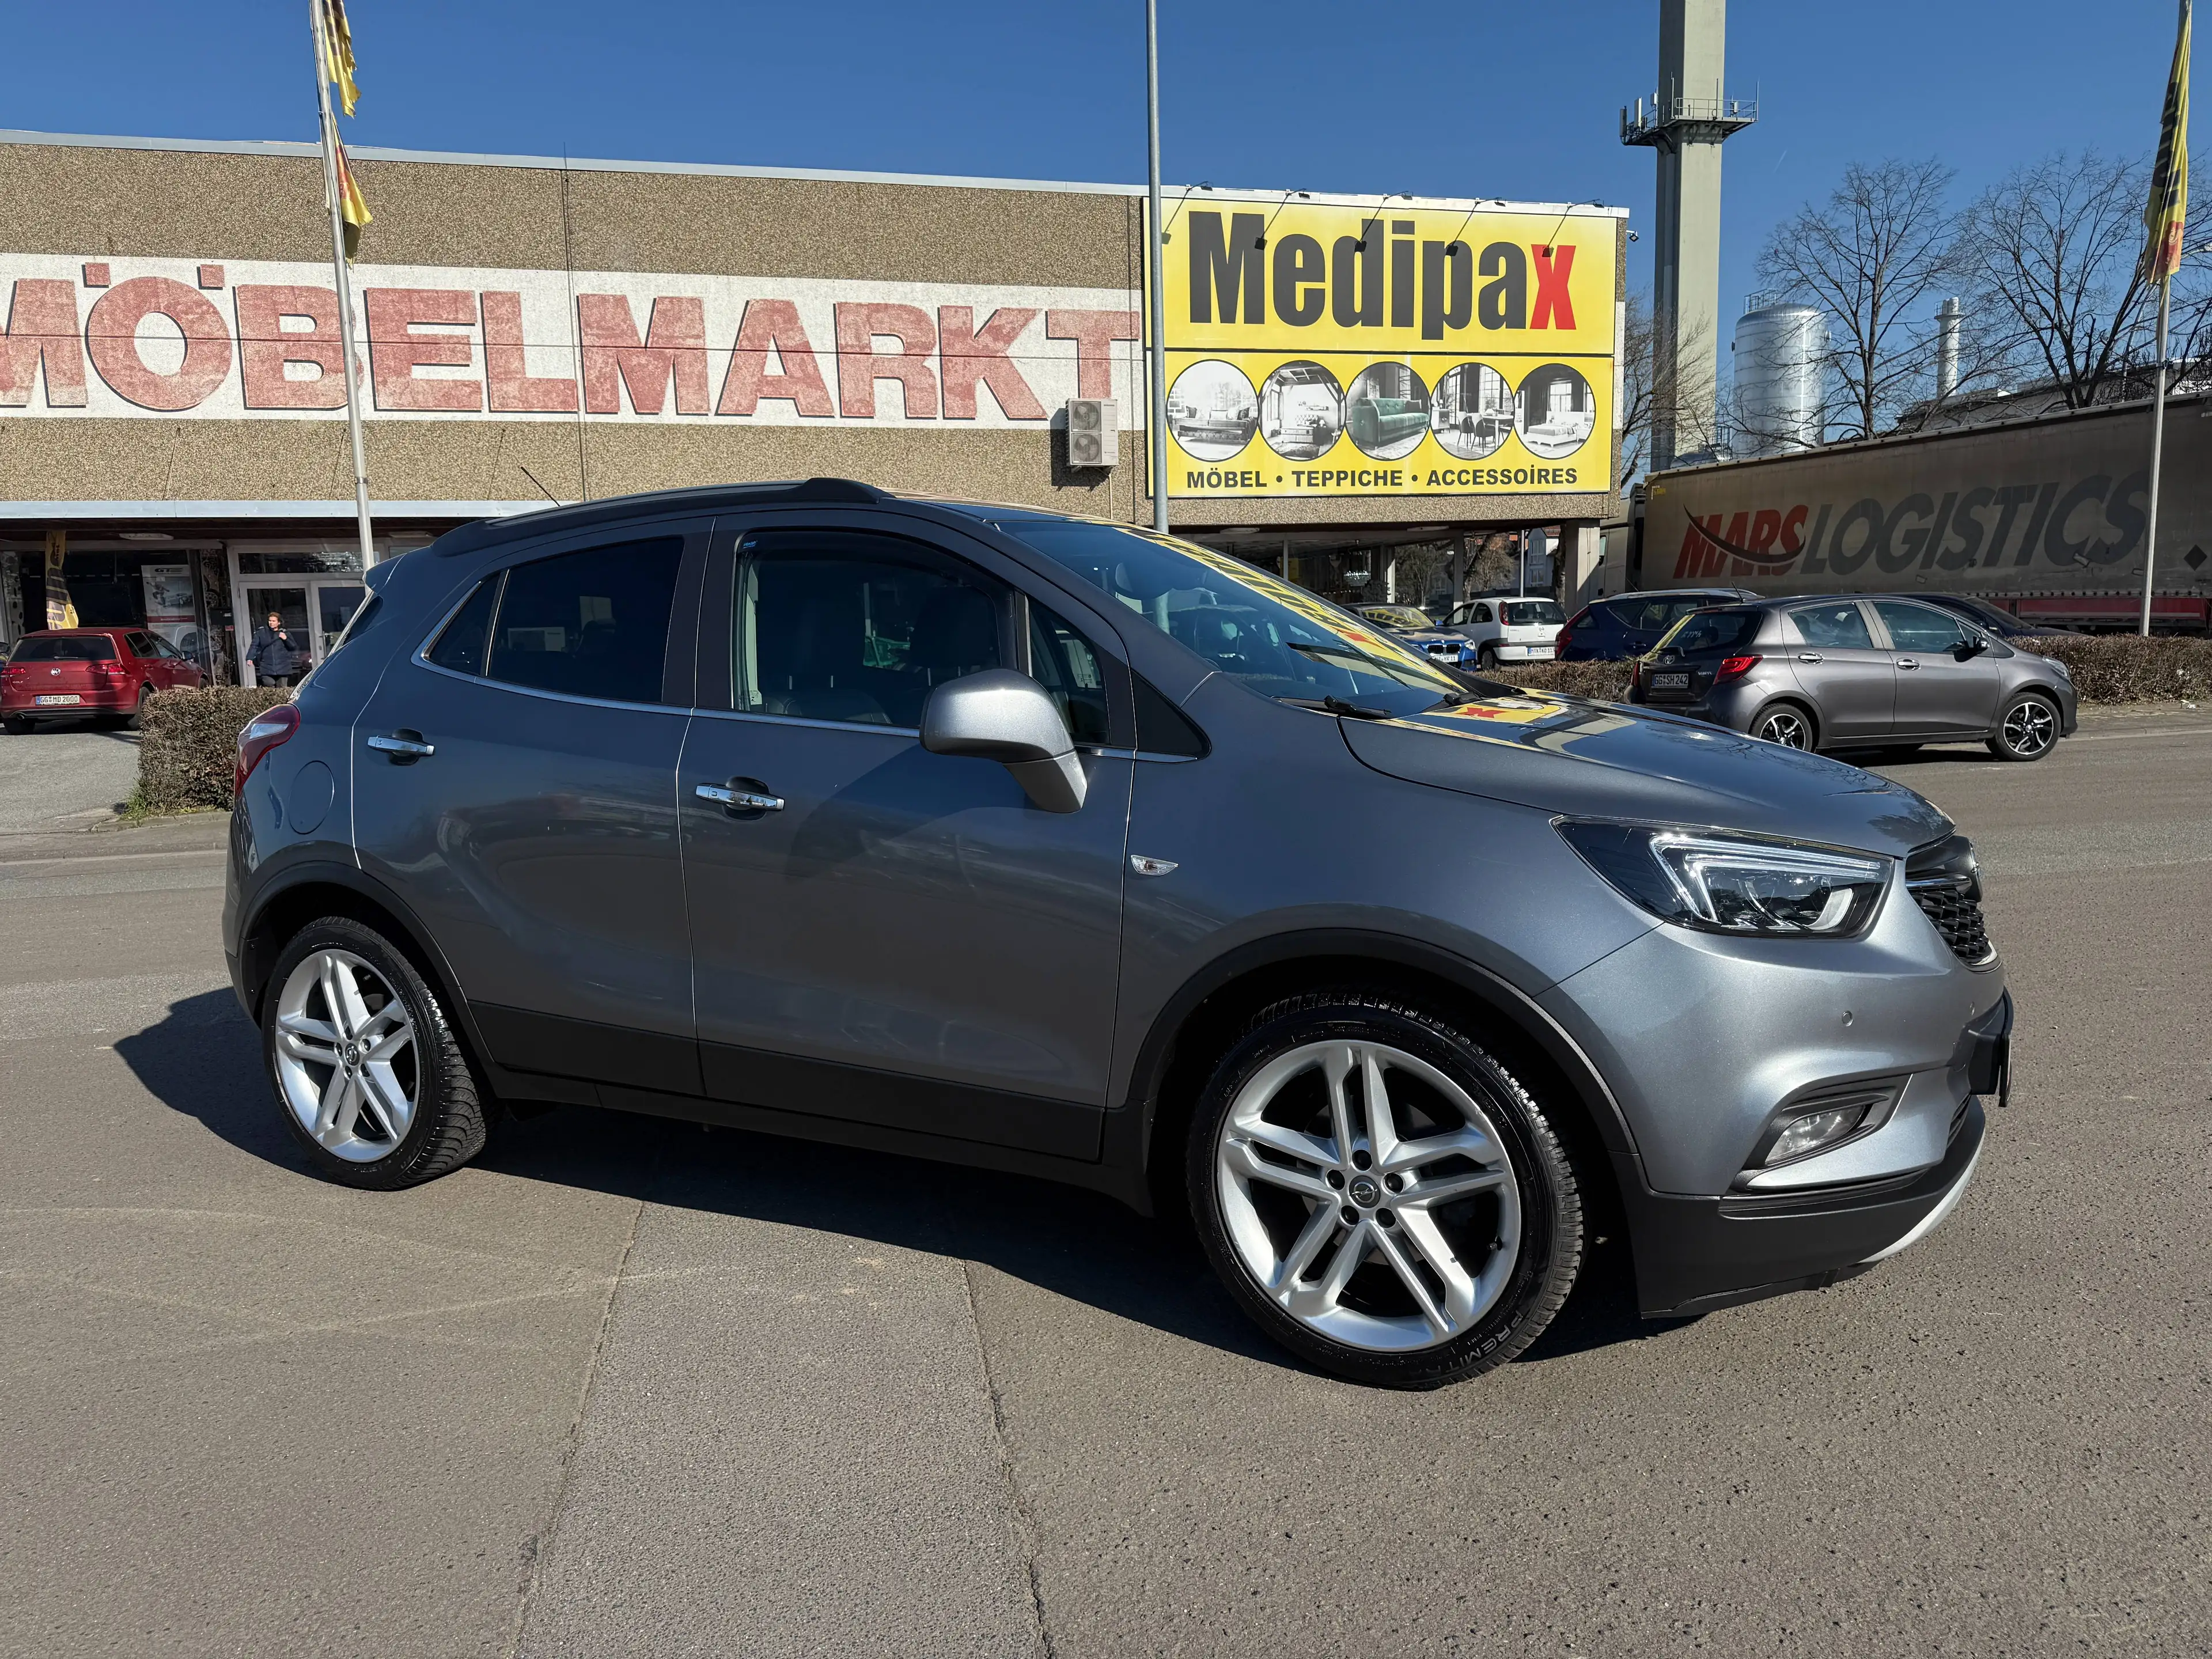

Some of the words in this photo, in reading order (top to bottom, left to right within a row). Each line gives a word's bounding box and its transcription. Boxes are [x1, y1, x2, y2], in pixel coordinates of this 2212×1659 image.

[1188, 211, 1577, 340] Medipax
[1187, 467, 1267, 488] MÖBEL
[1291, 469, 1403, 487] TEPPICHE
[1655, 675, 1662, 684] GG
[1666, 675, 1675, 684] SH
[1675, 675, 1688, 684] 242
